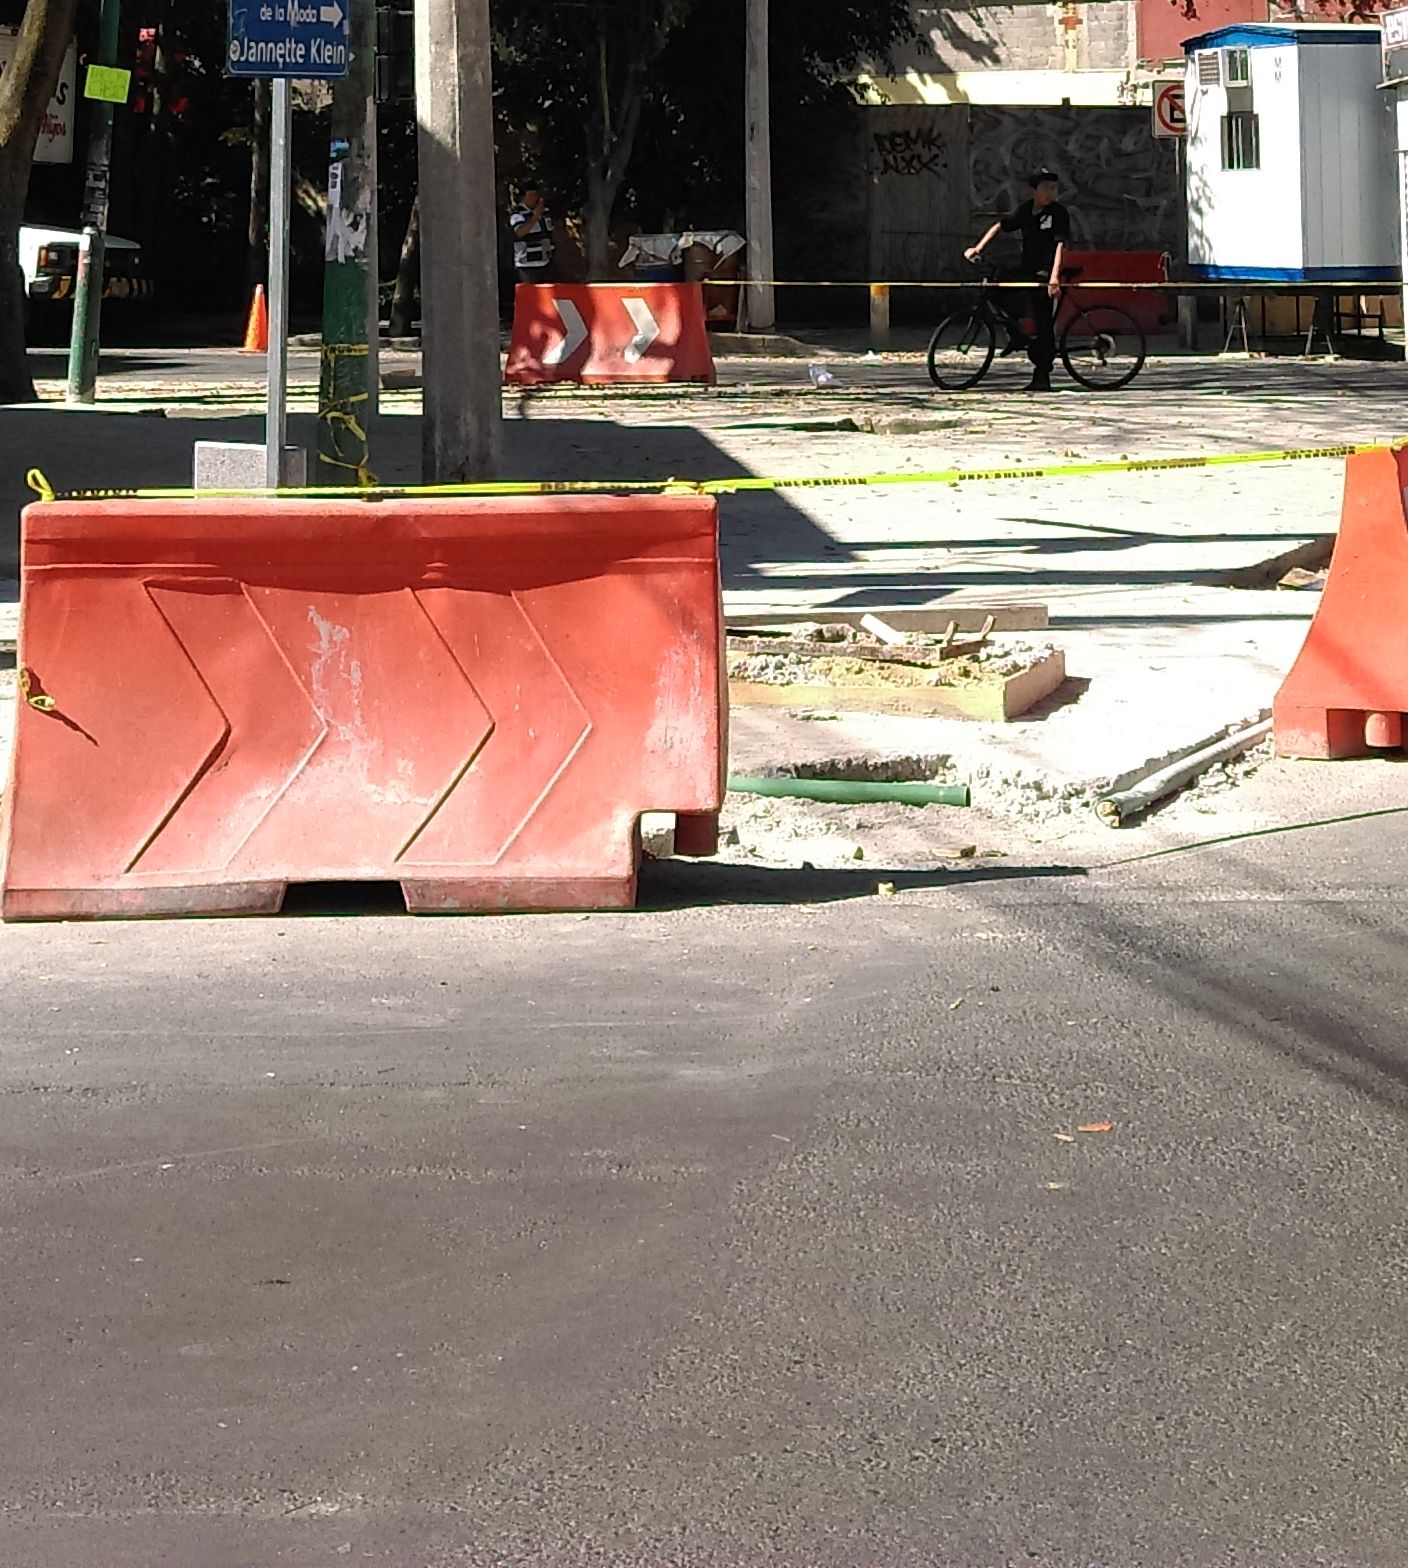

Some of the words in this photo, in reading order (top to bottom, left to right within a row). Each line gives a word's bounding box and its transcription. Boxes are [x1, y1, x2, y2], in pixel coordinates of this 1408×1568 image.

[259, 2, 273, 21] de
[275, 3, 285, 22] la
[239, 36, 306, 65] Jannette
[310, 36, 346, 65] Klein
